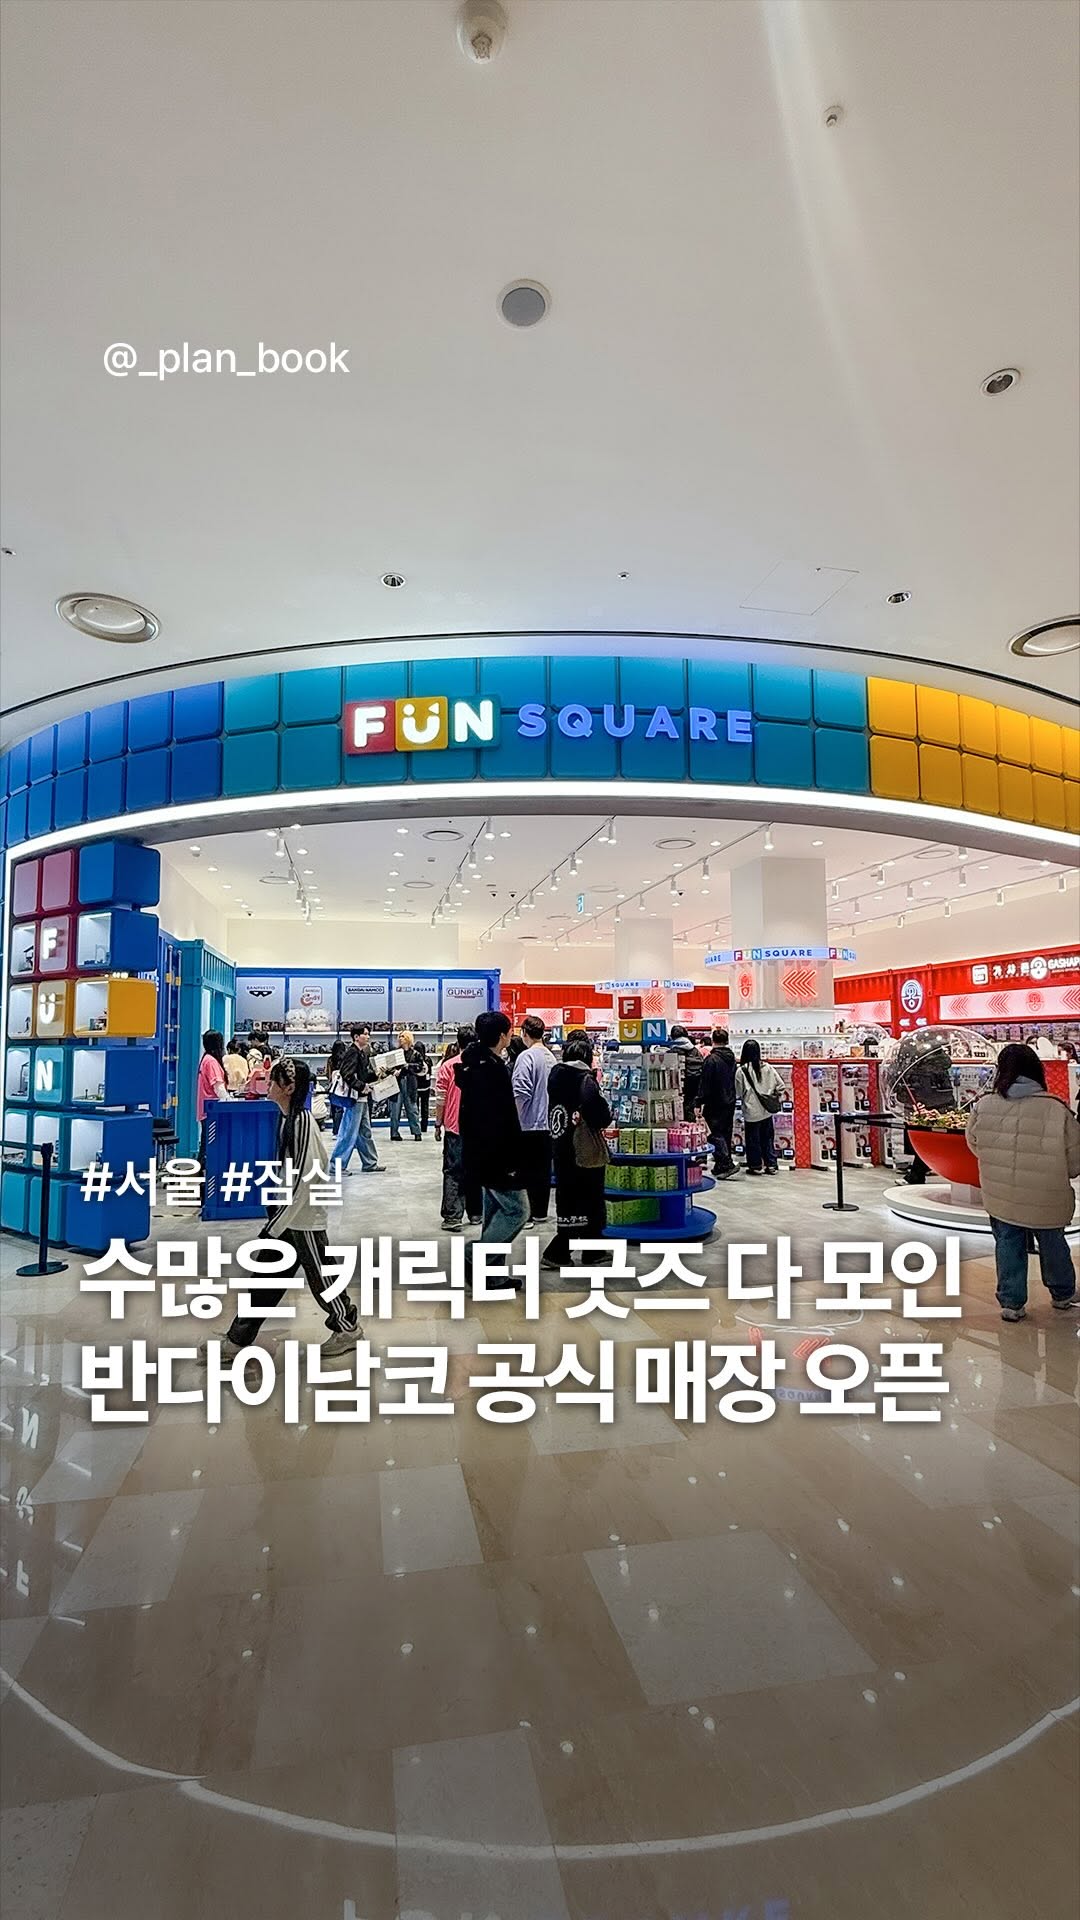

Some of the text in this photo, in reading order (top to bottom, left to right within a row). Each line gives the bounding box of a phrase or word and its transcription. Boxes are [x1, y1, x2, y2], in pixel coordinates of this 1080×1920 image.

[518, 704, 753, 743] SQUARE
[765, 949, 812, 957] SQUARE
[447, 988, 483, 996] GUNPLA
